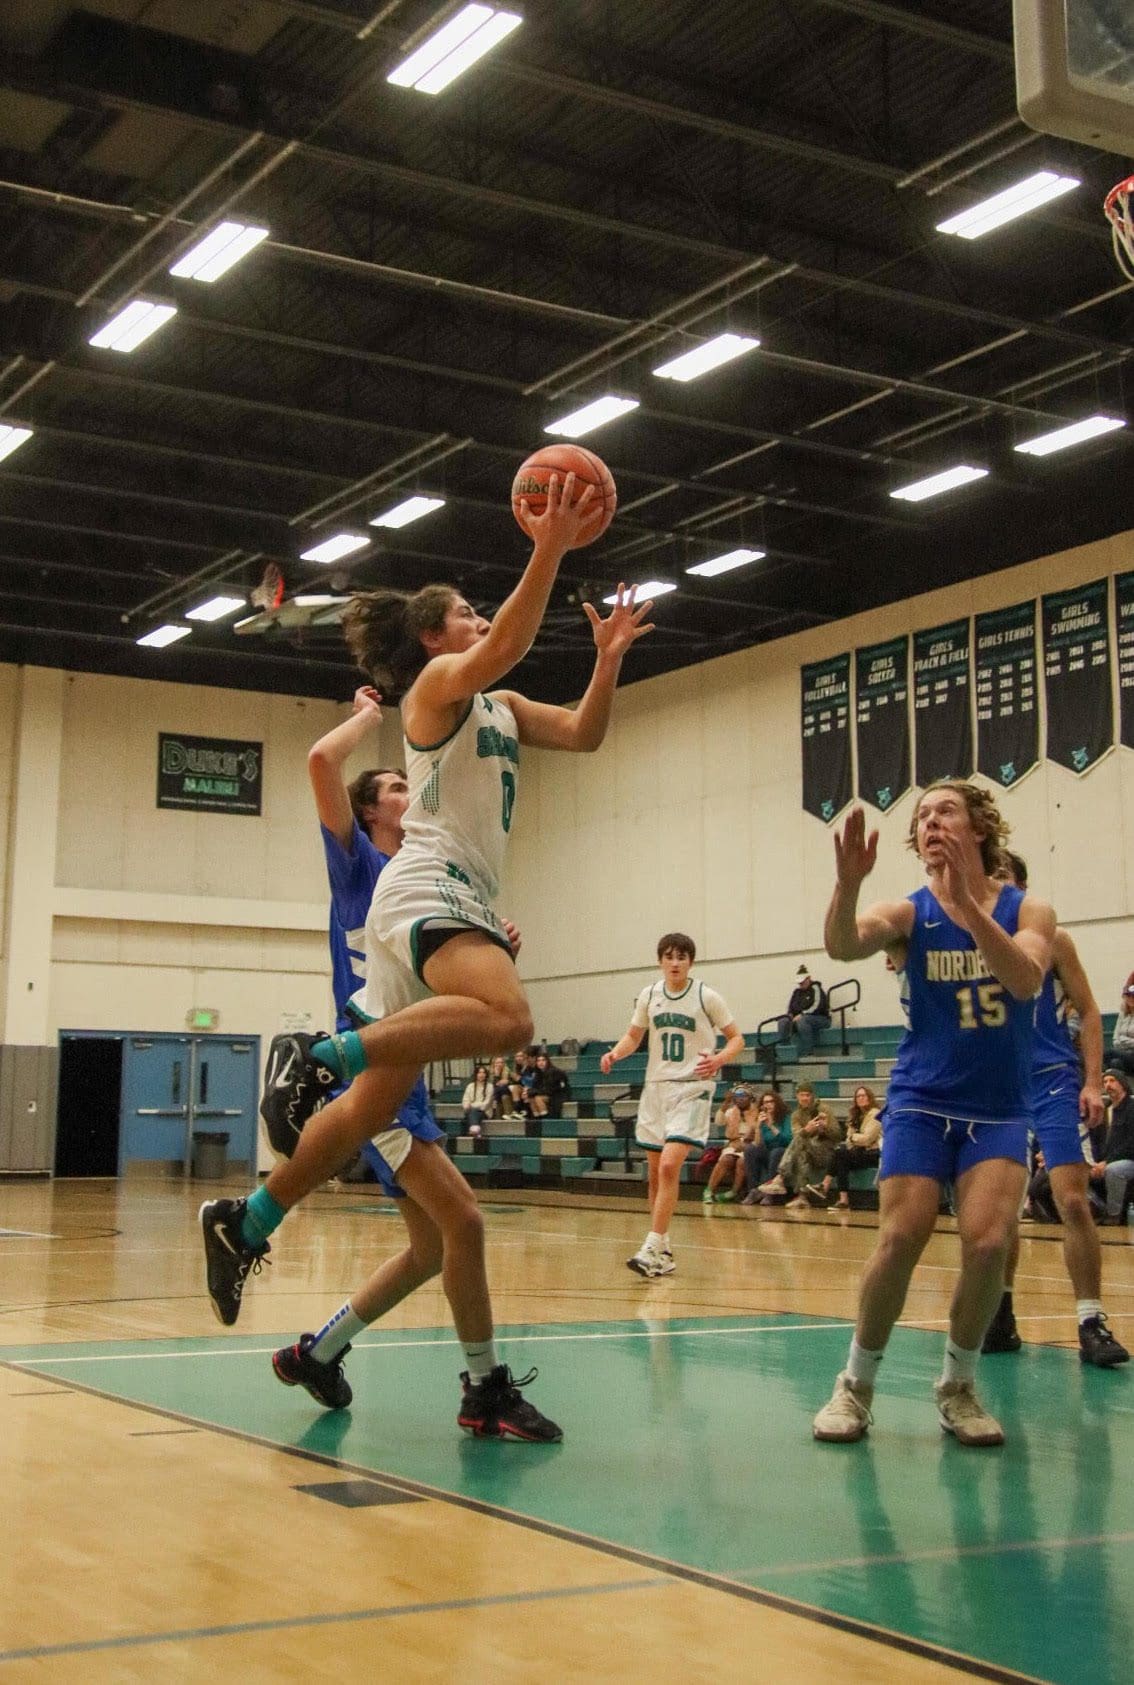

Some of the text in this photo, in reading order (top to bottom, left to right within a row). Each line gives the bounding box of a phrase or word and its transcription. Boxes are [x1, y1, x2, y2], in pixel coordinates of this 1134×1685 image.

[1061, 601, 1089, 620] GIRLS
[1051, 611, 1101, 636] SWIMMING
[929, 639, 953, 656] GIRLS
[978, 631, 1003, 650] GIRLS
[1004, 624, 1035, 644] TENNIS
[871, 655, 894, 672] GIRLS
[815, 672, 836, 688] GIRLS
[868, 667, 897, 685] SOCCER
[926, 949, 993, 982] NORDH
[956, 983, 1006, 1029] 15
[661, 1032, 685, 1062] 10
